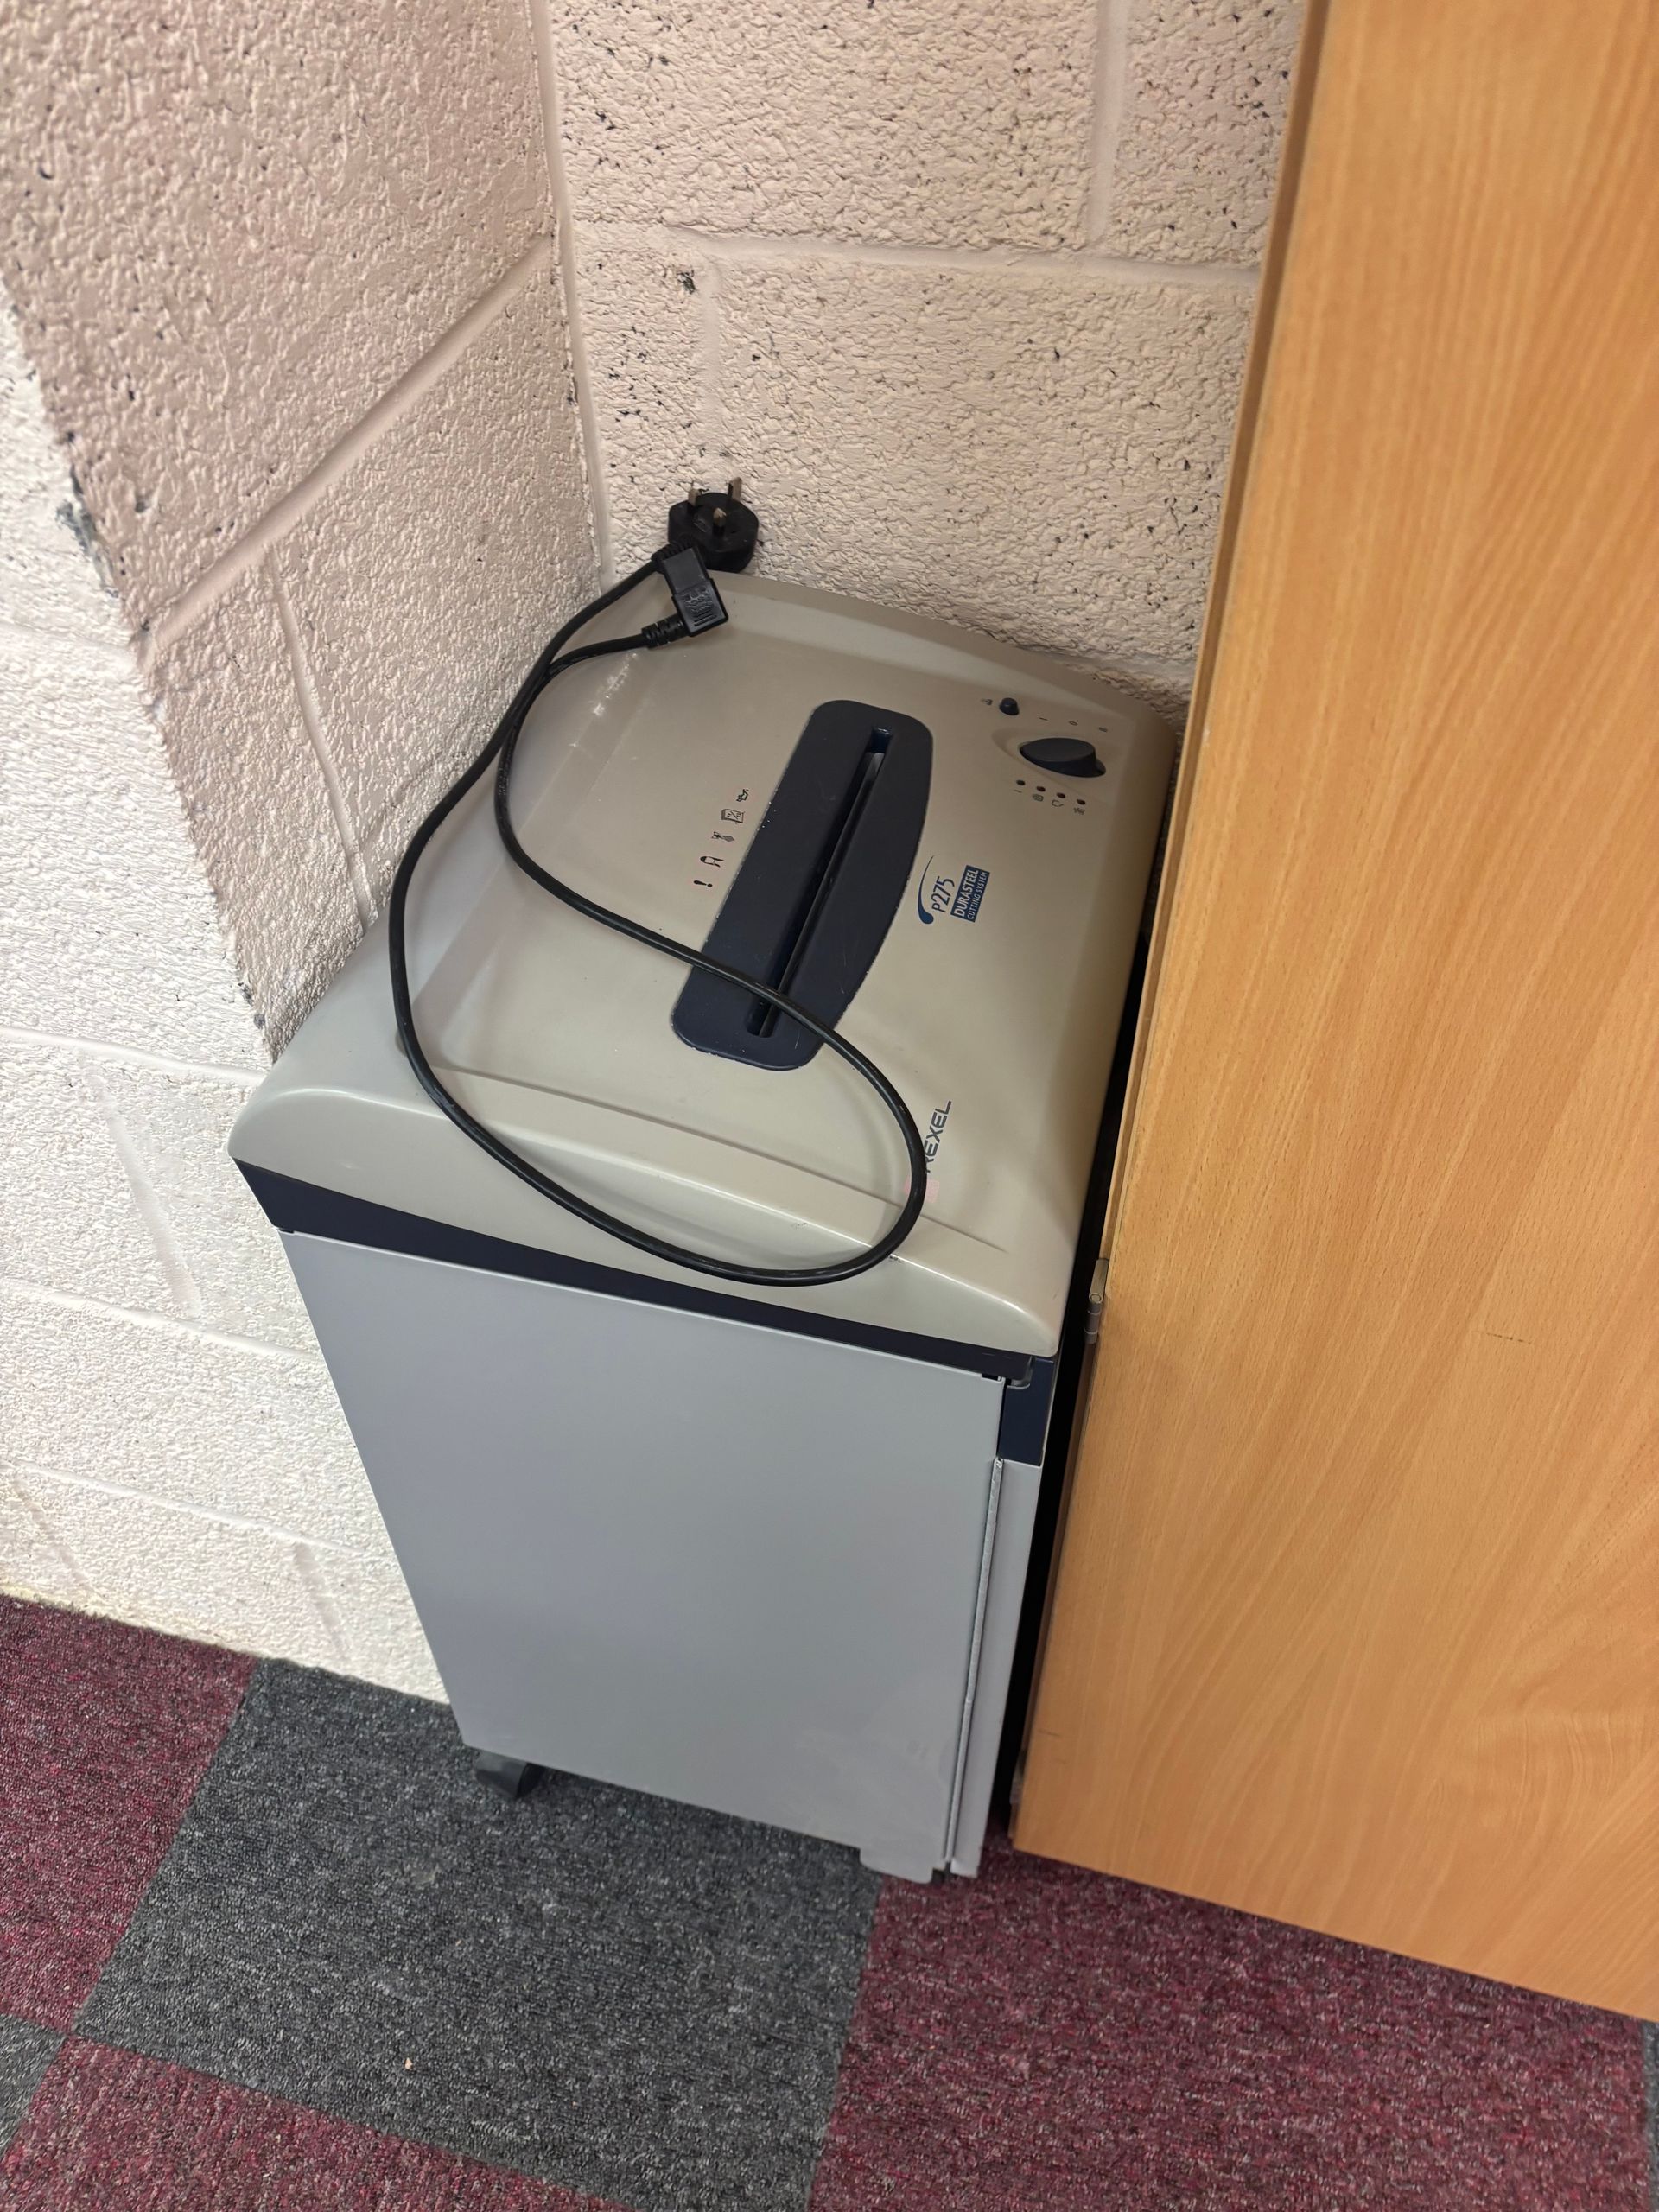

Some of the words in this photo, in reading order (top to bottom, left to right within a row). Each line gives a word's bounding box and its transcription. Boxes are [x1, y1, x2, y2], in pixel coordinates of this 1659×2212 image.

[931, 875, 956, 913] P275
[953, 868, 979, 918] DURASTEEL
[967, 893, 981, 920] CUTTING
[975, 872, 988, 894] SYSTEM
